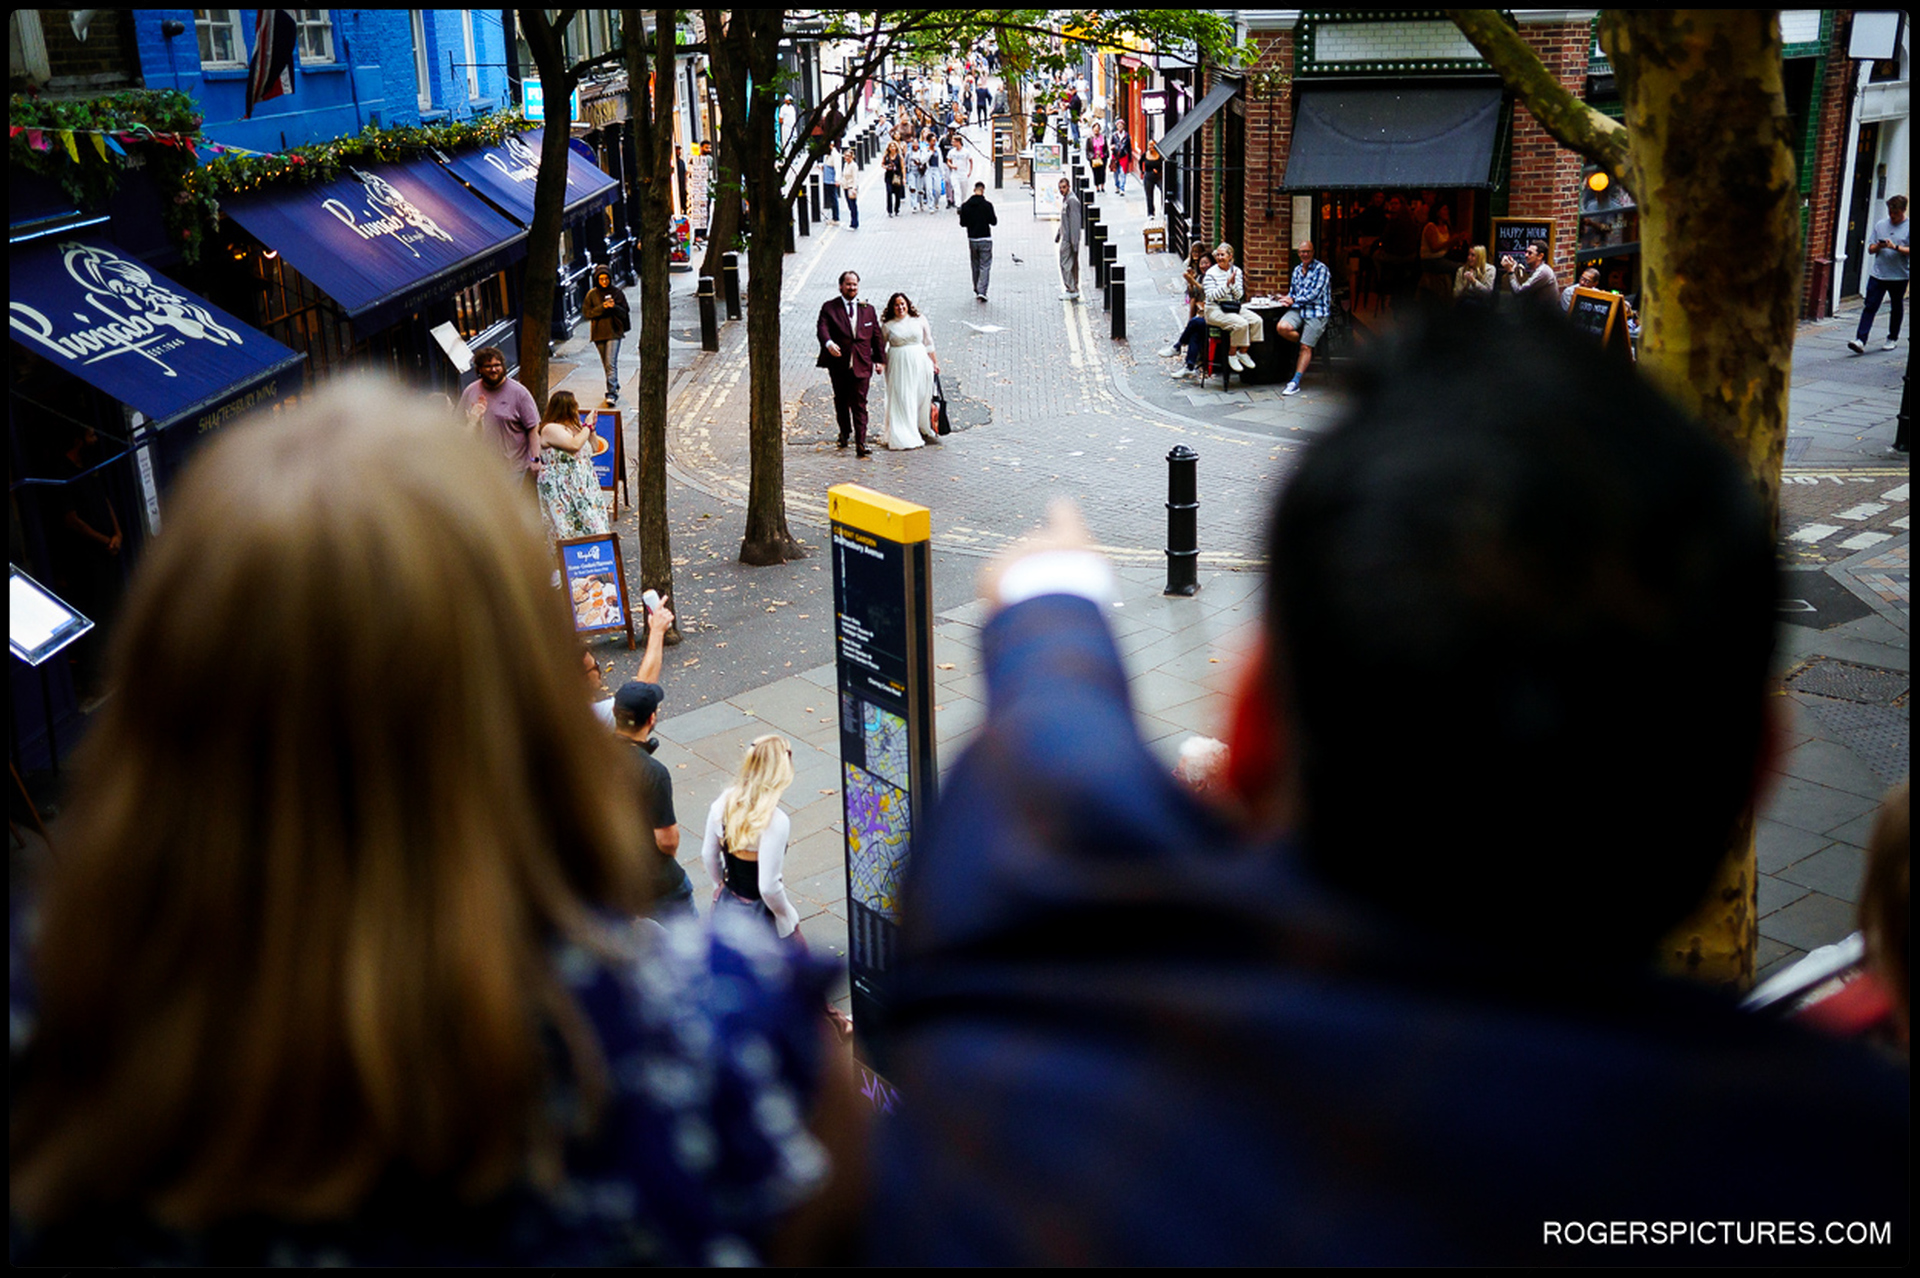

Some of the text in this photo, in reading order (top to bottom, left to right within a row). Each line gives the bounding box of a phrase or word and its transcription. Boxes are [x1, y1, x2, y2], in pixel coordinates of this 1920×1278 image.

[321, 198, 421, 258] Punjab
[1500, 226, 1525, 239] HAPPY
[9, 292, 178, 378] Punjab
